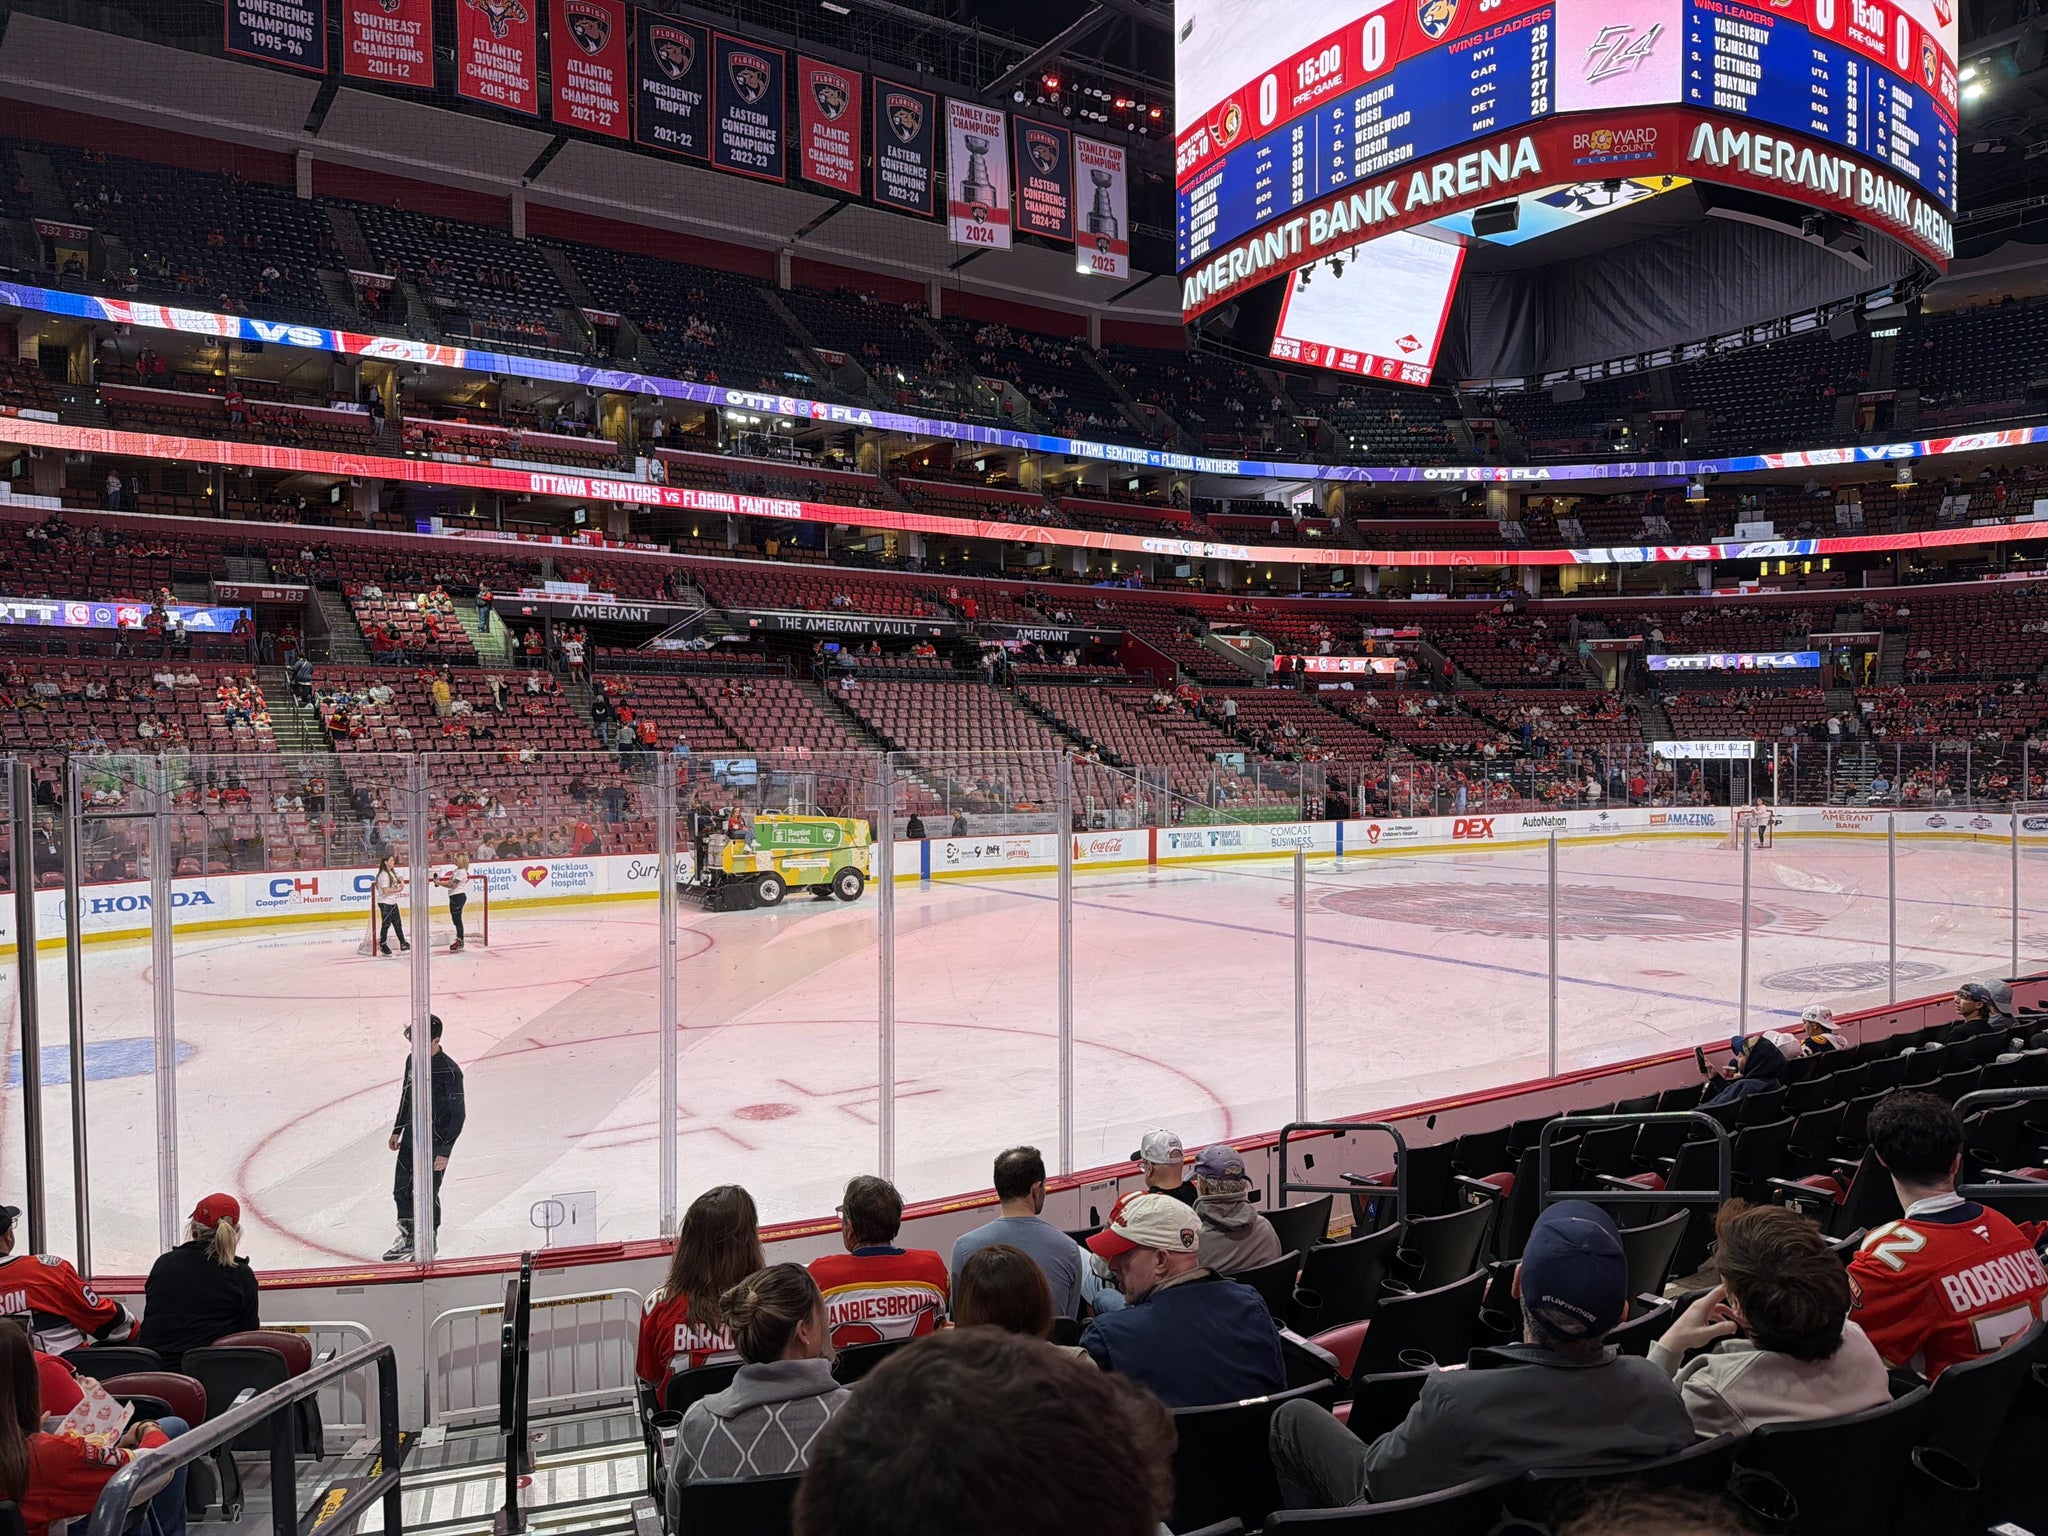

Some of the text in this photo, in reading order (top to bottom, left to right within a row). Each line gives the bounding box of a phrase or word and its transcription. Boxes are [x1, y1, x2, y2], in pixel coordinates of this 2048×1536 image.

[237, 0, 314, 26] CONFERENCE
[354, 11, 422, 35] SOUTHEAST
[1725, 5, 1774, 27] LEADERS
[1852, 0, 1884, 37] 15:00
[239, 11, 312, 41] CHAMPIONS
[1448, 9, 1552, 54] WINS LEADERS
[251, 31, 303, 55] 1995-96
[362, 27, 414, 48] DIVISION
[1362, 15, 1386, 72] 0
[1715, 18, 1828, 63] VASILEVSKIY TBL
[1849, 27, 1885, 55] PRE-GAME
[1896, 15, 1909, 70] 0
[353, 39, 423, 64] CHAMPIONS
[473, 37, 523, 63] ATLANTIC
[1715, 36, 1828, 80] VEJMELKA UTA
[368, 59, 410, 77] 2011-12
[475, 51, 521, 75] DIVISION
[567, 59, 613, 81] ATLANTIC
[1297, 44, 1340, 89] 15:00
[1355, 24, 1547, 112] SOROKIN NYI 28
[466, 63, 529, 91] CHAMPIONS
[568, 74, 612, 97] DIVISION
[1355, 42, 1547, 128] BUSSI CAR 27
[1714, 54, 1828, 97] OETTINGER DAL
[480, 82, 520, 104] 2015-16
[562, 88, 619, 114] CHAMPIONS
[643, 78, 702, 105] PRESIDENTS'
[1260, 73, 1277, 126] 0
[1293, 74, 1342, 108] PRE-GAME
[1714, 73, 1828, 115] SWAYMAN BOS
[655, 97, 692, 118] TROPHY
[1355, 60, 1547, 144] WEDGEWOOD COL 27
[1714, 91, 1828, 133] DOSTAL ANA
[571, 105, 611, 127] 2021-22
[730, 106, 769, 127] EASTERN
[950, 104, 1001, 125] STANLEY CUP
[1355, 78, 1547, 161] GIBSON DET 27
[654, 125, 692, 147] 2021-22
[722, 118, 777, 142] CONFERENCE
[813, 123, 850, 143] ATLANTIC
[953, 117, 1000, 137] CHAMPIONS
[1355, 97, 1547, 177] GUSTAVSSON MIN 26
[723, 132, 775, 155] CHAMPIONS
[814, 137, 849, 157] DIVISION
[1078, 140, 1122, 161] STANLEY CUP
[1257, 126, 1303, 159] TBL 35
[1614, 143, 1655, 154] COUNTY
[731, 150, 768, 168] 2022-23
[808, 148, 854, 172] CHAMPIONS
[887, 145, 921, 164] EASTERN
[1080, 153, 1121, 173] CHAMPIONS
[1256, 142, 1303, 174] UTA 33
[1577, 152, 1653, 164] FLORIDA
[816, 164, 847, 183] 2023-24
[881, 156, 927, 180] CONFERENCE
[882, 170, 926, 193] CHAMPIONS
[1030, 177, 1060, 193] EASTERN
[1256, 177, 1272, 190] DAL
[1688, 122, 1856, 198] AMERANT
[1861, 168, 1911, 226] BANK
[1914, 199, 1954, 258] ARENA
[888, 185, 919, 203] 2023-24
[1024, 188, 1067, 208] CONFERENCE
[1256, 191, 1272, 205] BOS
[1025, 201, 1066, 219] CHAMPIONS
[1256, 207, 1272, 220] ANA
[1031, 214, 1061, 230] 2024-25
[1183, 136, 1541, 310] AMERANT BANK ARENA
[966, 225, 994, 243] 2024
[1091, 255, 1115, 273] 2025
[249, 320, 323, 346] VS
[1325, 348, 1335, 367] 0
[1363, 354, 1373, 374] 0
[726, 391, 872, 425] OTT FLA
[1070, 441, 1103, 454] OTTAWA
[1106, 445, 1147, 463] SENATORS
[1162, 453, 1194, 470] FLORIDA
[1196, 459, 1239, 474] PANTHERS
[1861, 444, 1915, 459] VS
[1423, 468, 1551, 479] OTT FLA
[530, 474, 586, 496] OTTAWA
[591, 479, 660, 503] SENATORS
[683, 491, 735, 512] FLORIDA
[738, 496, 800, 518] PANTHERS
[1142, 539, 1248, 558] OTT FLA
[1663, 546, 1711, 560] VS
[219, 588, 304, 602] 132 133
[571, 604, 651, 621] AMERANT
[778, 617, 917, 635] THE AMERANT VAULT
[1017, 629, 1070, 642] AMERANT
[1818, 636, 1870, 645] 107 108
[1666, 656, 1797, 668] OTT FLA
[1452, 818, 1495, 839] DEX
[1522, 816, 1567, 828] AutoNation
[1668, 813, 1716, 826] AMAZING
[788, 829, 811, 838] Baptist
[788, 836, 809, 844] Health
[1180, 832, 1202, 840] TROPICAL
[1220, 830, 1241, 839] TROPICAL
[1270, 825, 1312, 836] COMCAST
[1090, 838, 1123, 853] Coca-Cola
[1271, 837, 1314, 848] BUSINESS
[473, 867, 511, 875] Nicklaus
[551, 862, 588, 872] Nicklaus
[551, 870, 594, 879] Children's
[551, 878, 586, 887] Hospital
[90, 891, 215, 914] HONDA
[255, 898, 288, 908] Cooper
[302, 895, 334, 904] Hunter
[340, 894, 371, 902] Cooper
[82, 1285, 98, 1307] 6
